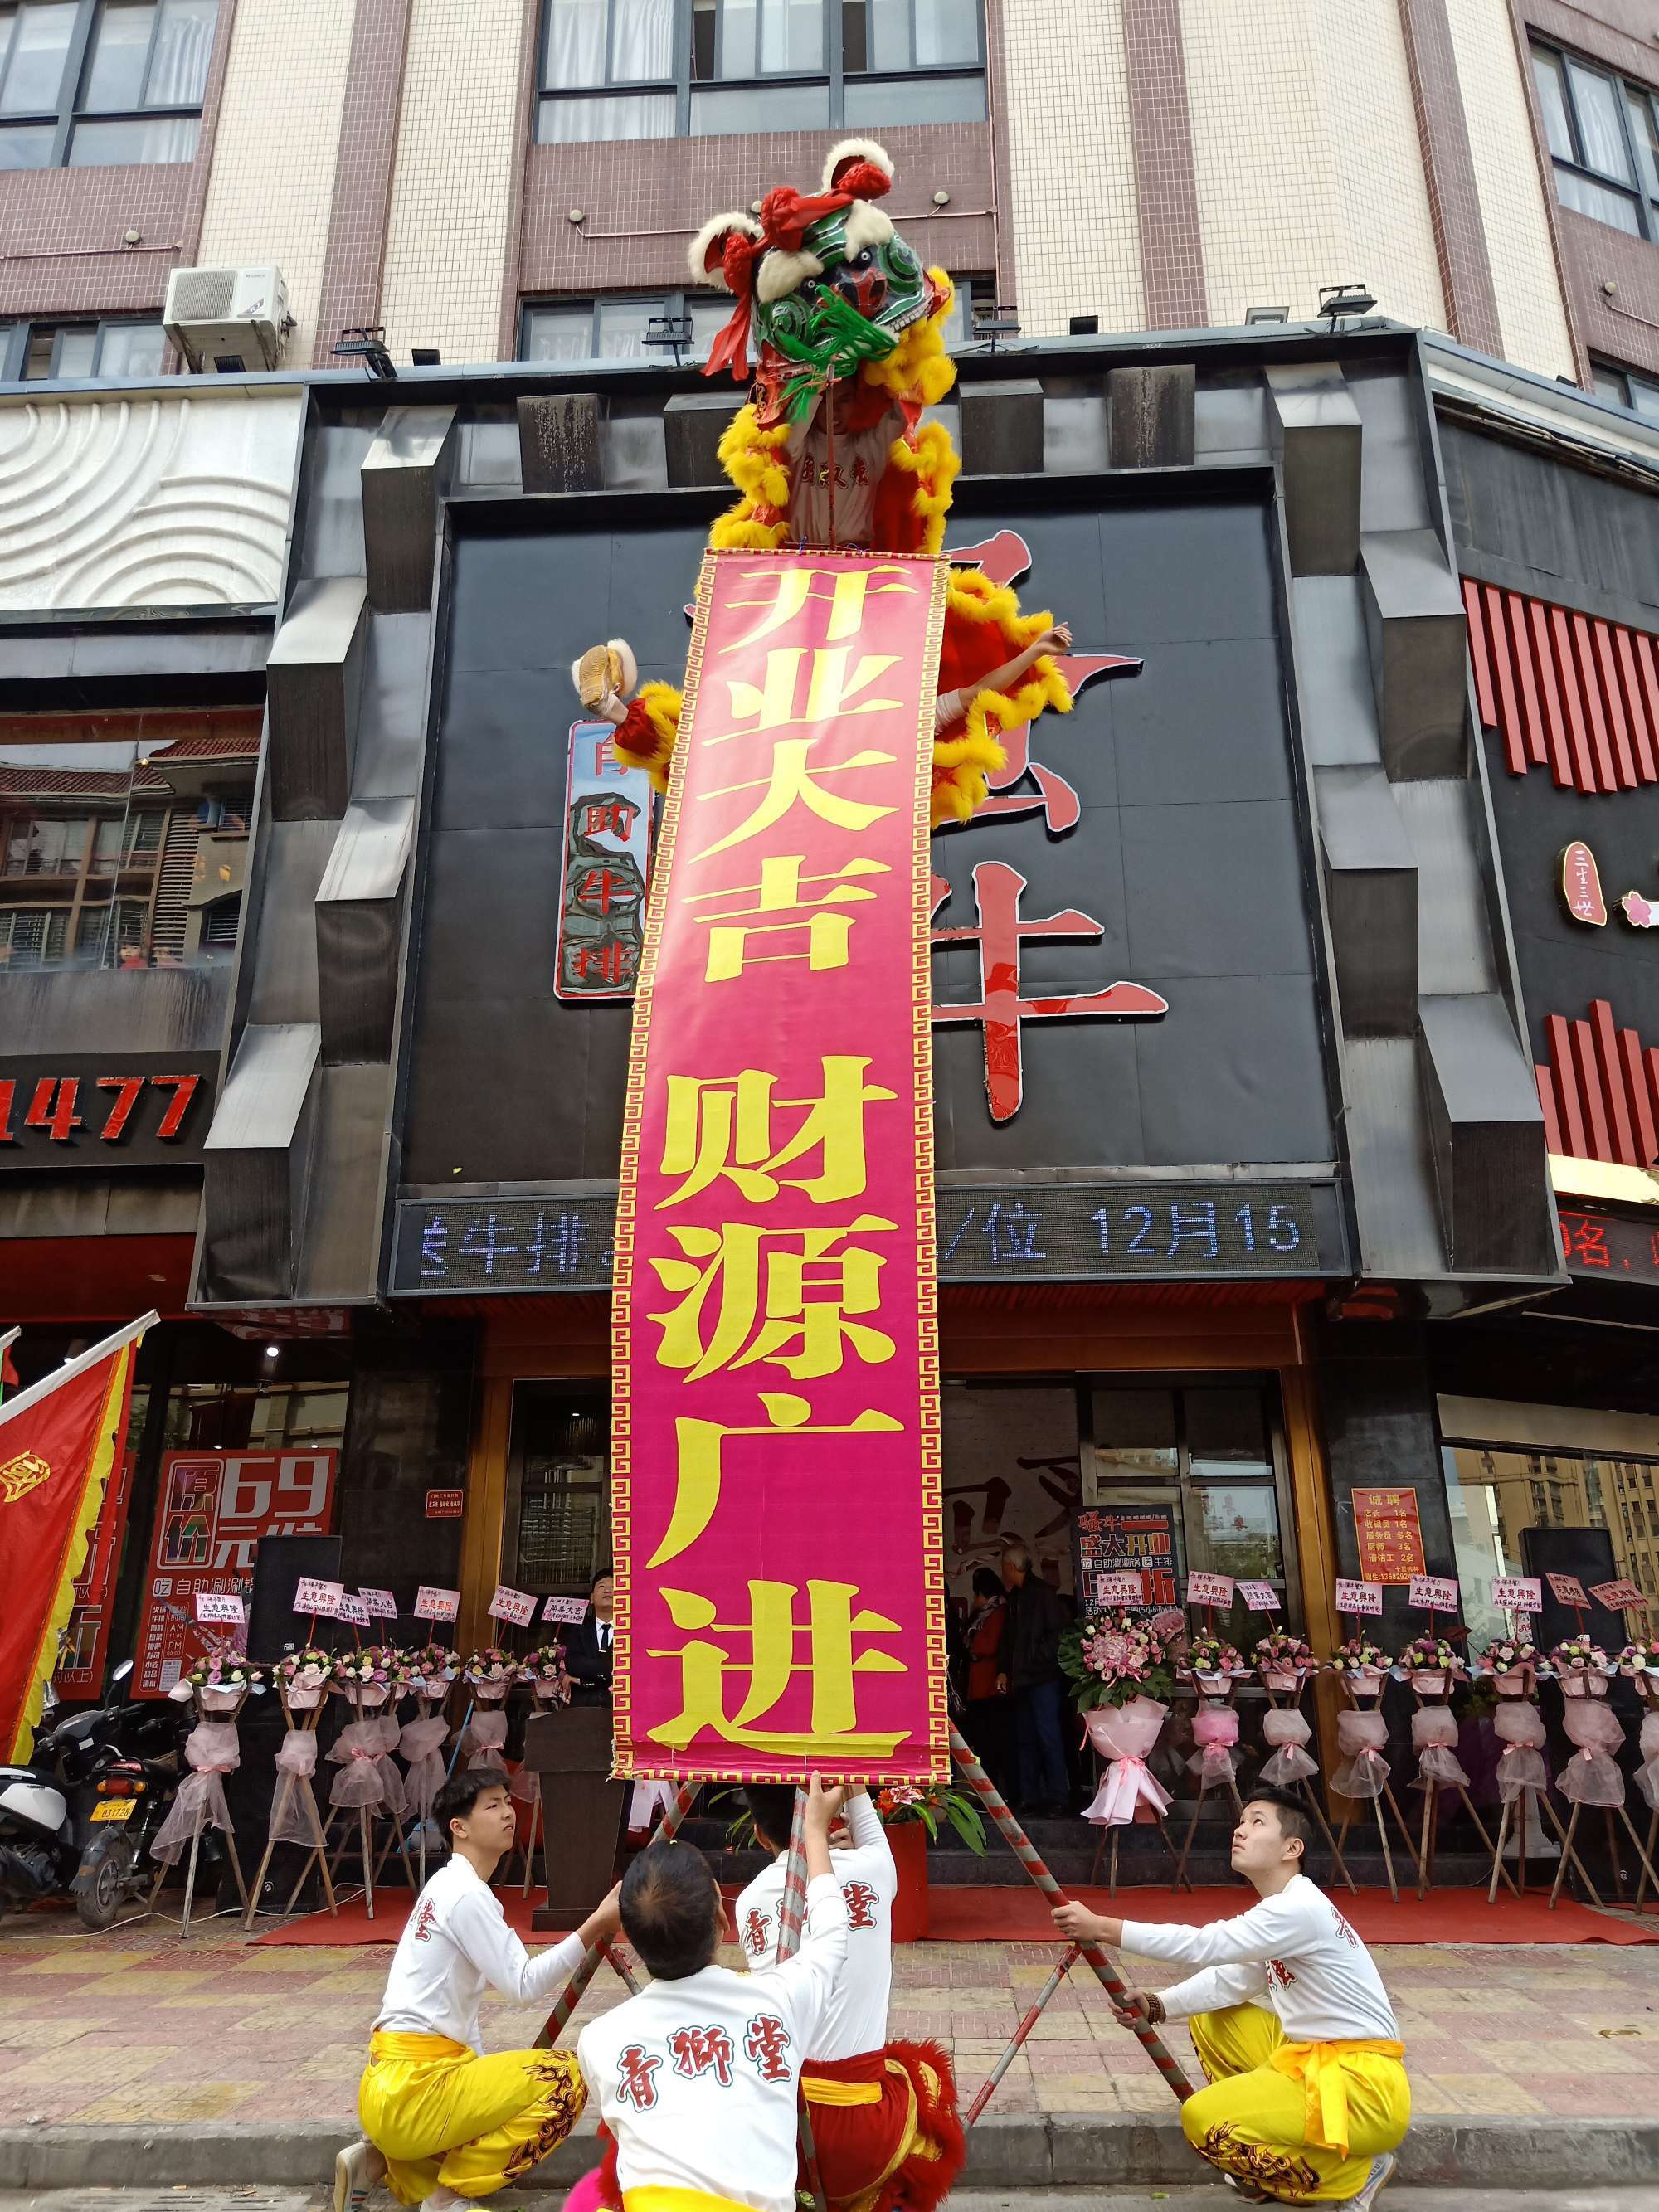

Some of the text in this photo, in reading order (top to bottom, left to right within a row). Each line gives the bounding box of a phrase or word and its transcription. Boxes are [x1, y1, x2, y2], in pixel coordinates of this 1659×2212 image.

[682, 564, 918, 984] 开业大吉
[572, 732, 635, 983] 自助牛排
[1573, 849, 1594, 916] 三生三世
[645, 1055, 914, 1758] 财源广进
[1369, 1494, 1400, 1506] 诚聘
[165, 1465, 219, 1563] 原价
[220, 1456, 330, 1519] 69
[1364, 1509, 1407, 1517] 店长 1名
[1365, 1520, 1408, 1529] 收银员 1名
[1366, 1531, 1413, 1540] 服务员 多名
[1080, 1533, 1171, 1558] 盛大开业
[1367, 1542, 1411, 1551] 厨师 3名
[1154, 1557, 1173, 1567] 牛排
[1369, 1553, 1414, 1563] 清洁工 2名
[153, 1578, 171, 1597] 吃
[170, 1624, 184, 1632] AM
[168, 1641, 182, 1650] PM
